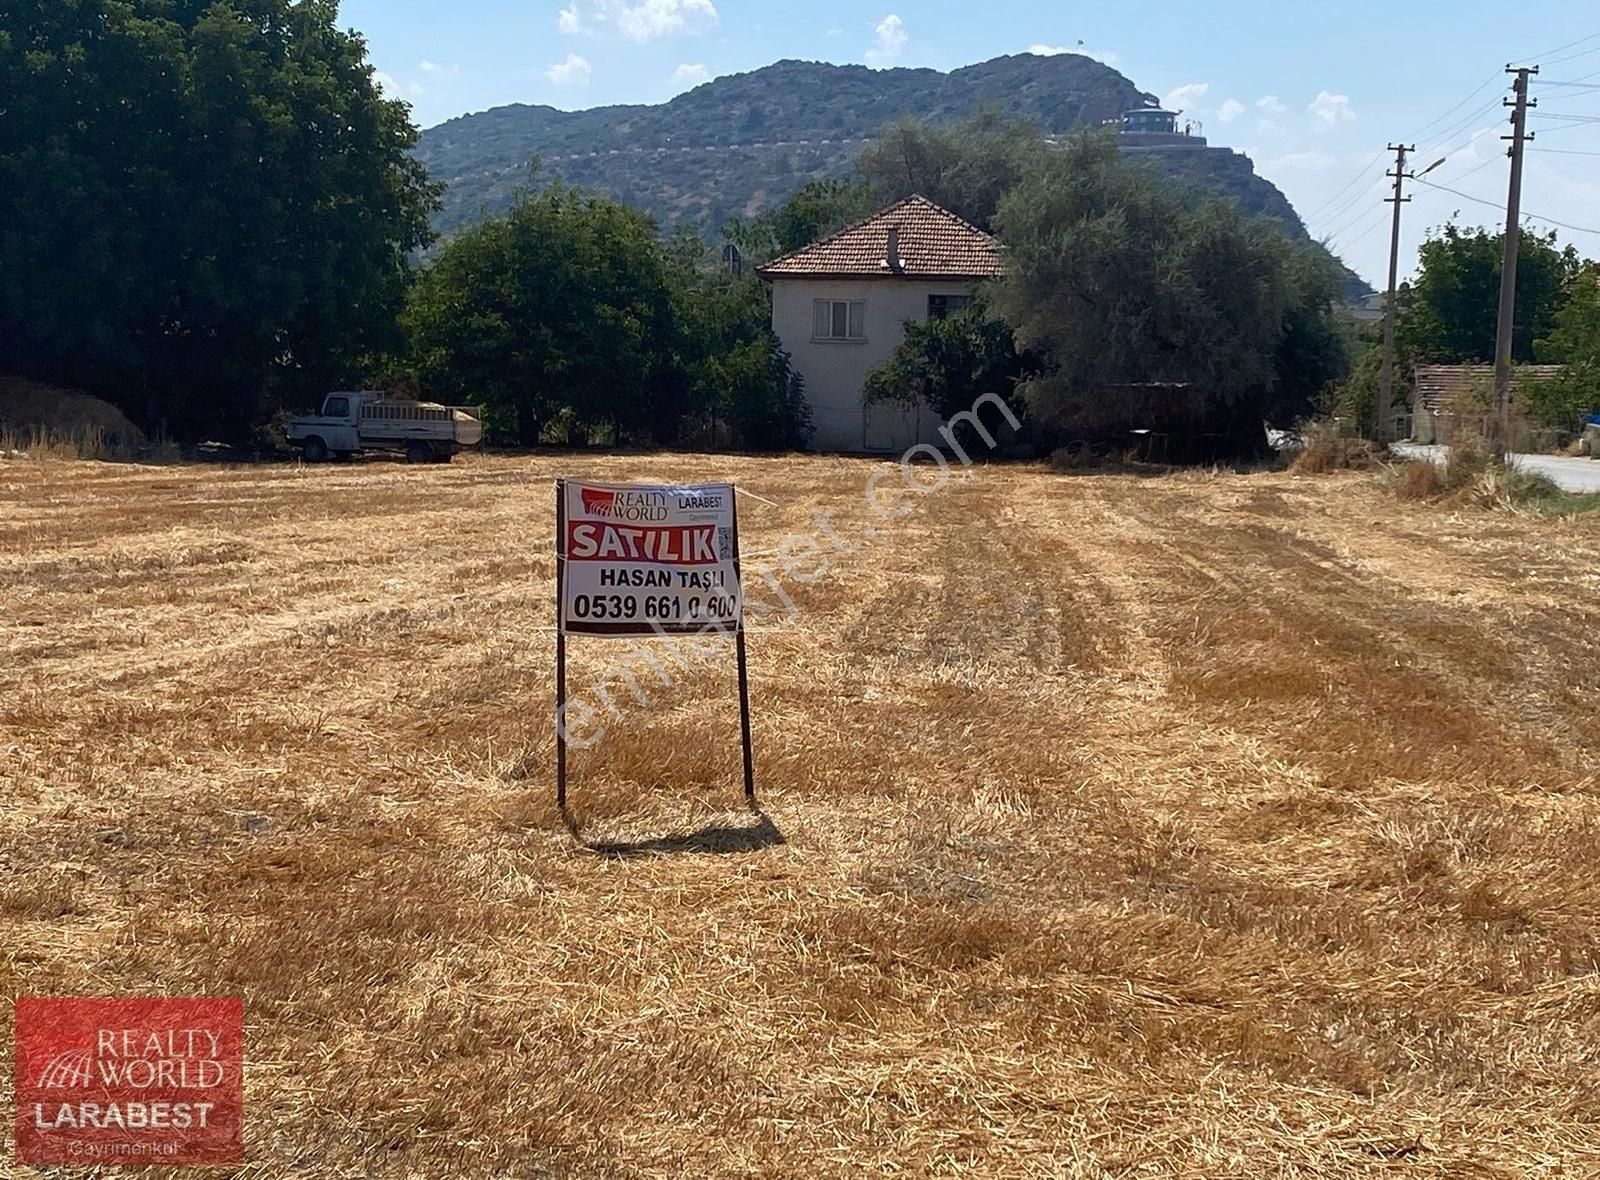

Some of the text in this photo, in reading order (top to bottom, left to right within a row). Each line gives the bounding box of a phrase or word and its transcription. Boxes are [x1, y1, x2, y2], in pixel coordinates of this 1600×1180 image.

[615, 492, 667, 507] REALTY
[678, 496, 723, 509] LARABEST
[613, 506, 669, 521] WORLD
[571, 524, 714, 561] SATILIK
[600, 569, 725, 593] HASAN TAŞLI
[574, 594, 736, 619] 0539 661 0 600
